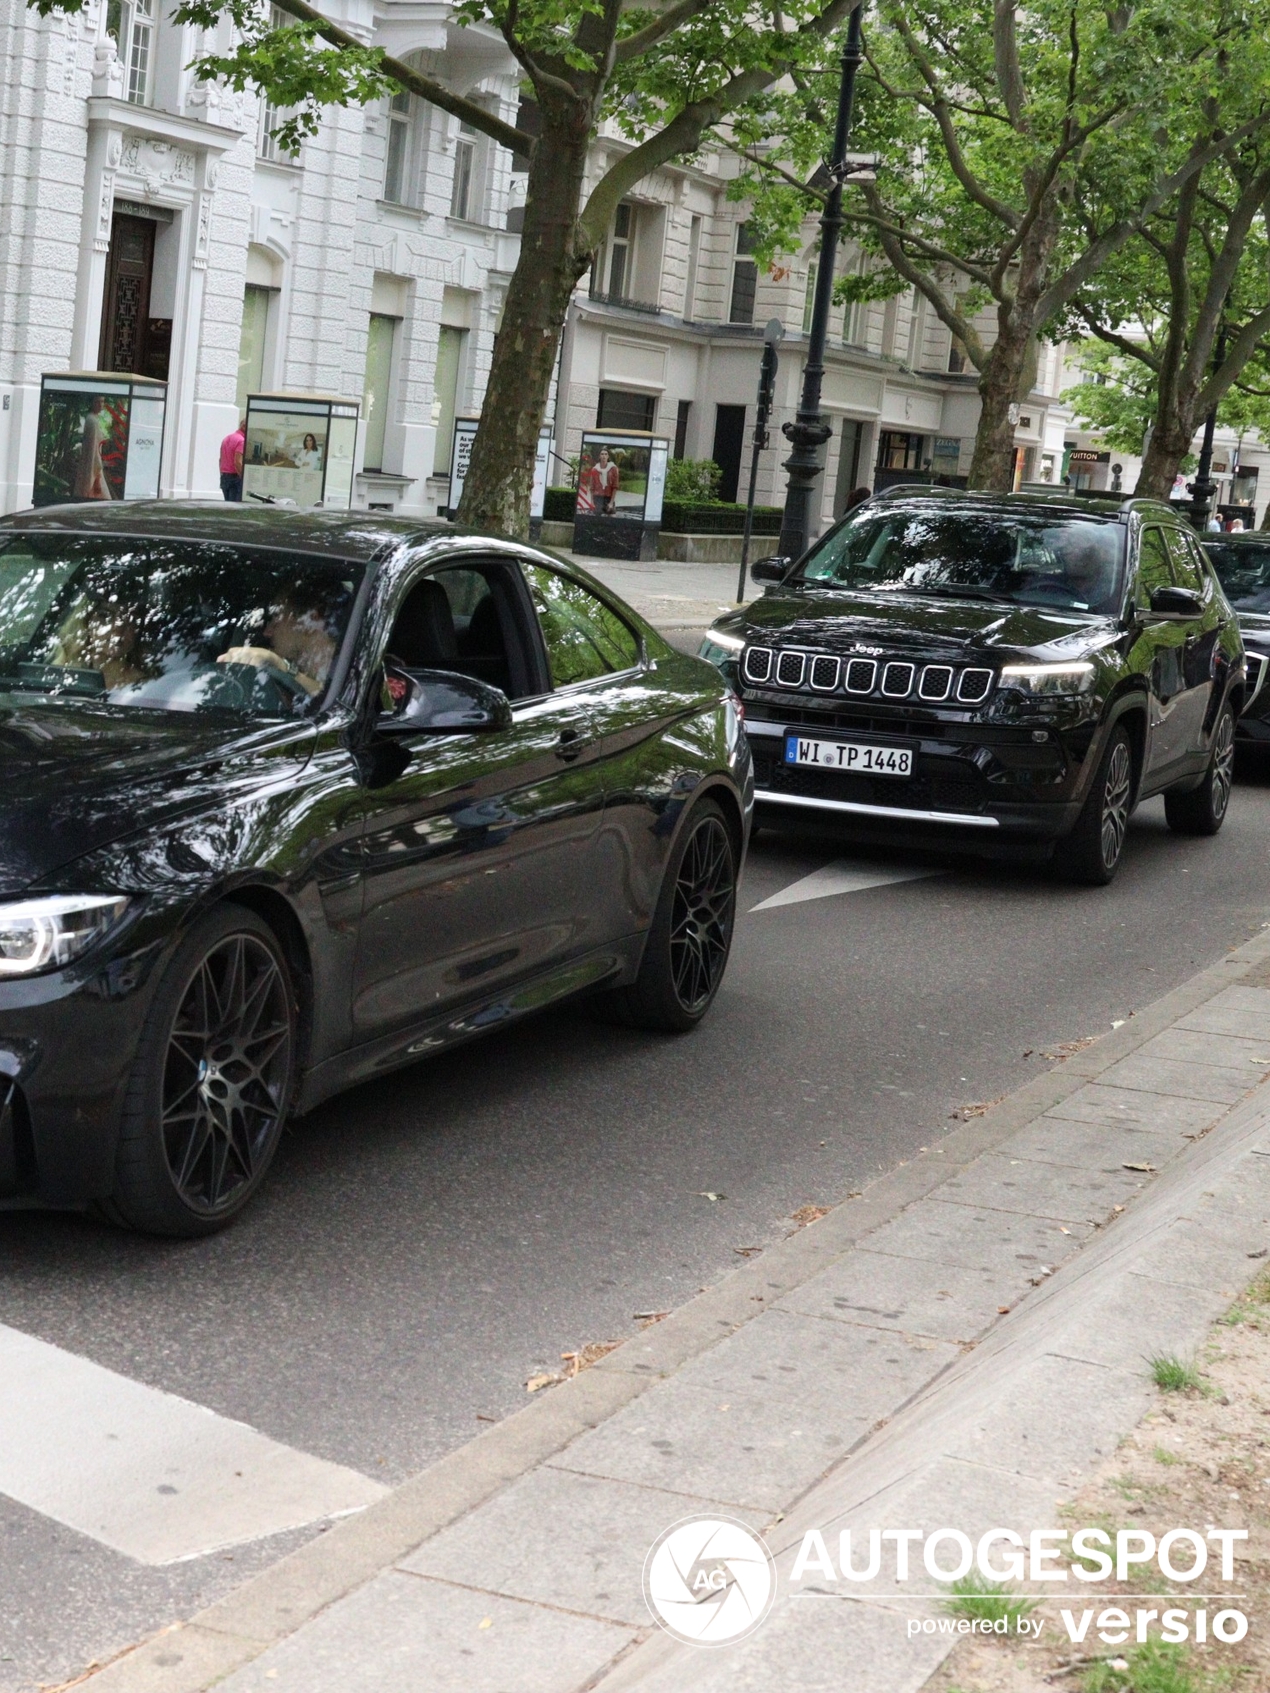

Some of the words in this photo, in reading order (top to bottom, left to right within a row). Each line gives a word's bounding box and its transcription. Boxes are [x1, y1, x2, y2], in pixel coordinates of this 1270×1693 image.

[849, 643, 884, 656] Jeep
[799, 741, 820, 763] WI
[836, 745, 859, 767] TP
[862, 749, 910, 773] 1448
